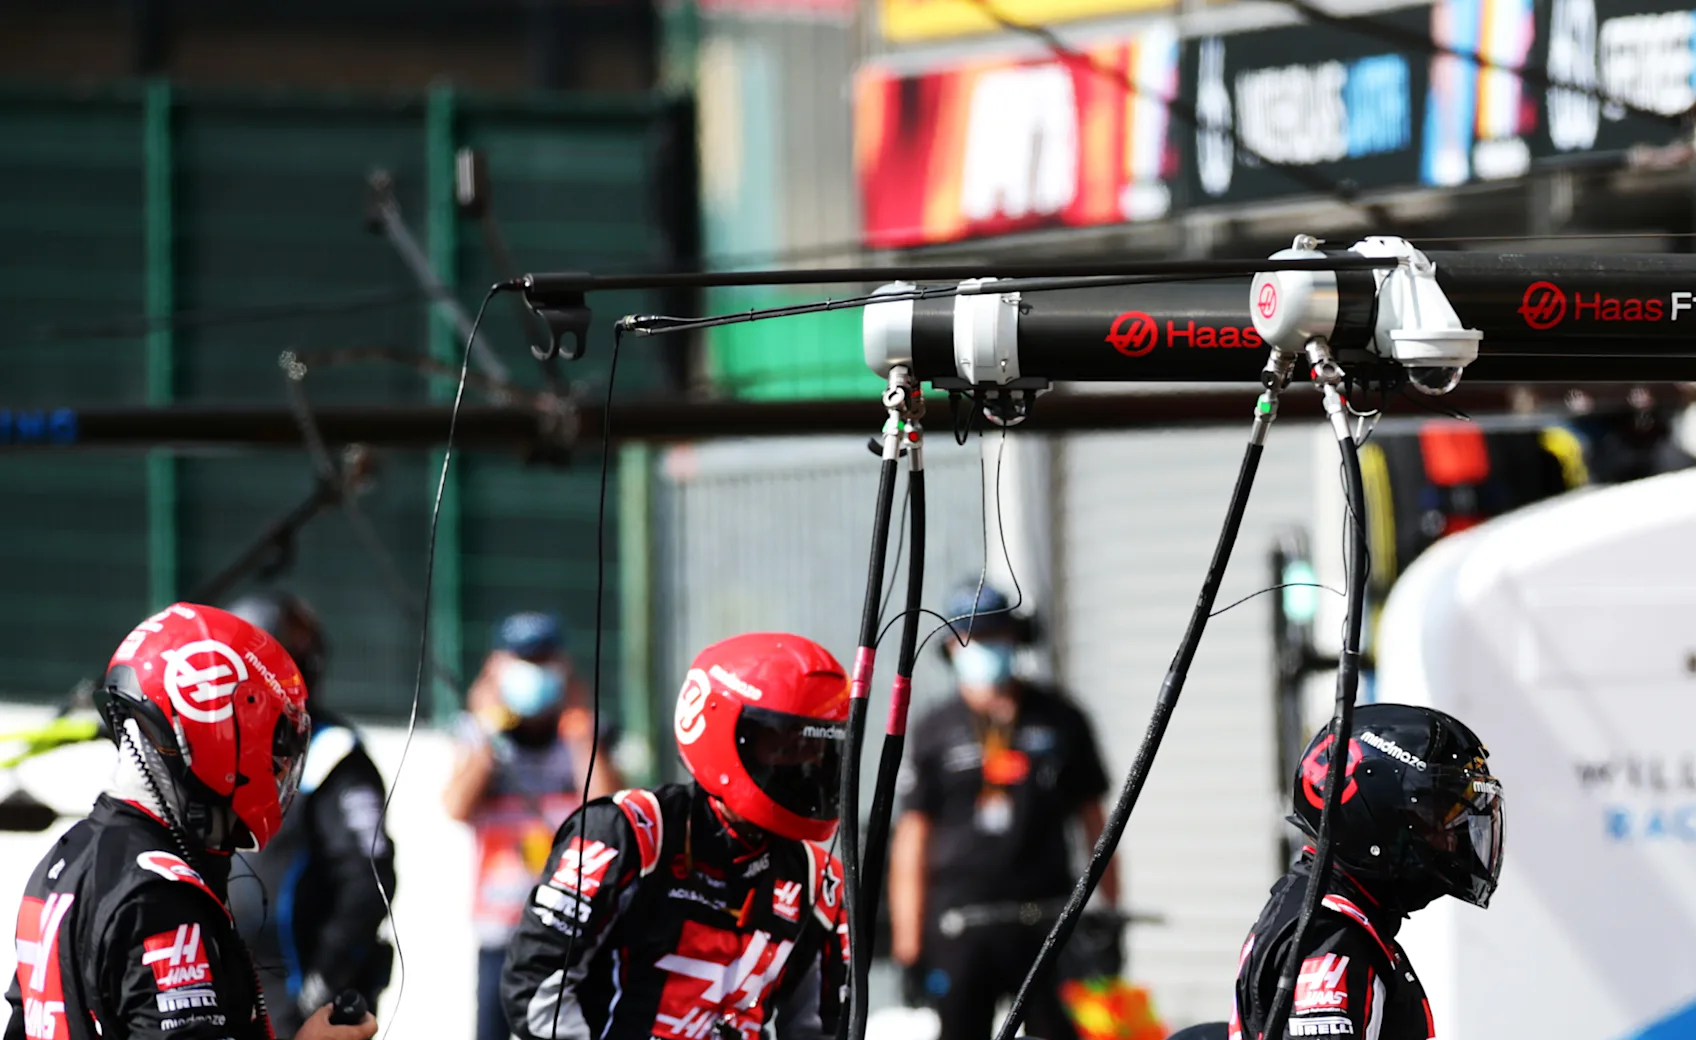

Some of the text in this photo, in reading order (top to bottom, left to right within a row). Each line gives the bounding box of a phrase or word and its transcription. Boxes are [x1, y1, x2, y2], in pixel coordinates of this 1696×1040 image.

[1574, 291, 1664, 322] Haas
[1166, 320, 1263, 348] Haas
[1360, 731, 1427, 772] mindmaze
